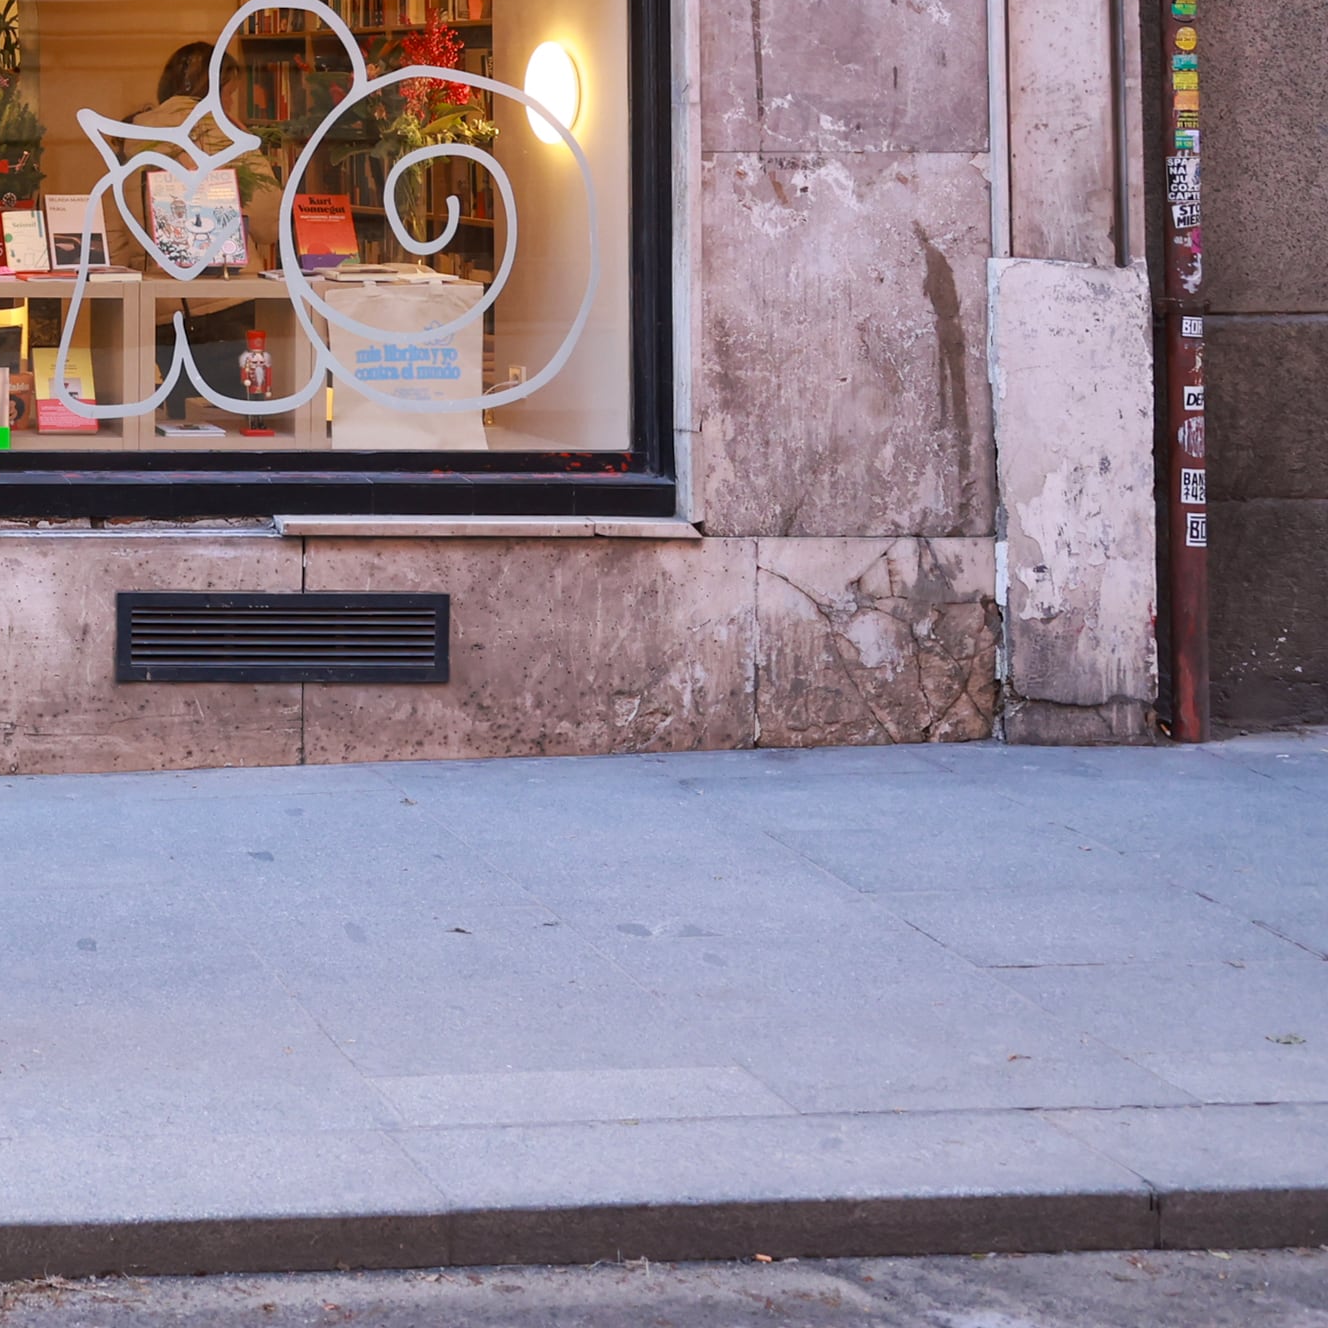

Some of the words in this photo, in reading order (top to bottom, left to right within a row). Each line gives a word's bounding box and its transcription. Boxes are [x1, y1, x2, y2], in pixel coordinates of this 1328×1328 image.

[308, 197, 332, 205] Kurt
[298, 204, 346, 215] Vonnegut
[356, 345, 382, 363] mis
[431, 348, 440, 364] y
[441, 348, 458, 365] yo
[355, 365, 400, 381] contra
[401, 363, 414, 380] el
[416, 363, 462, 380] mundo
